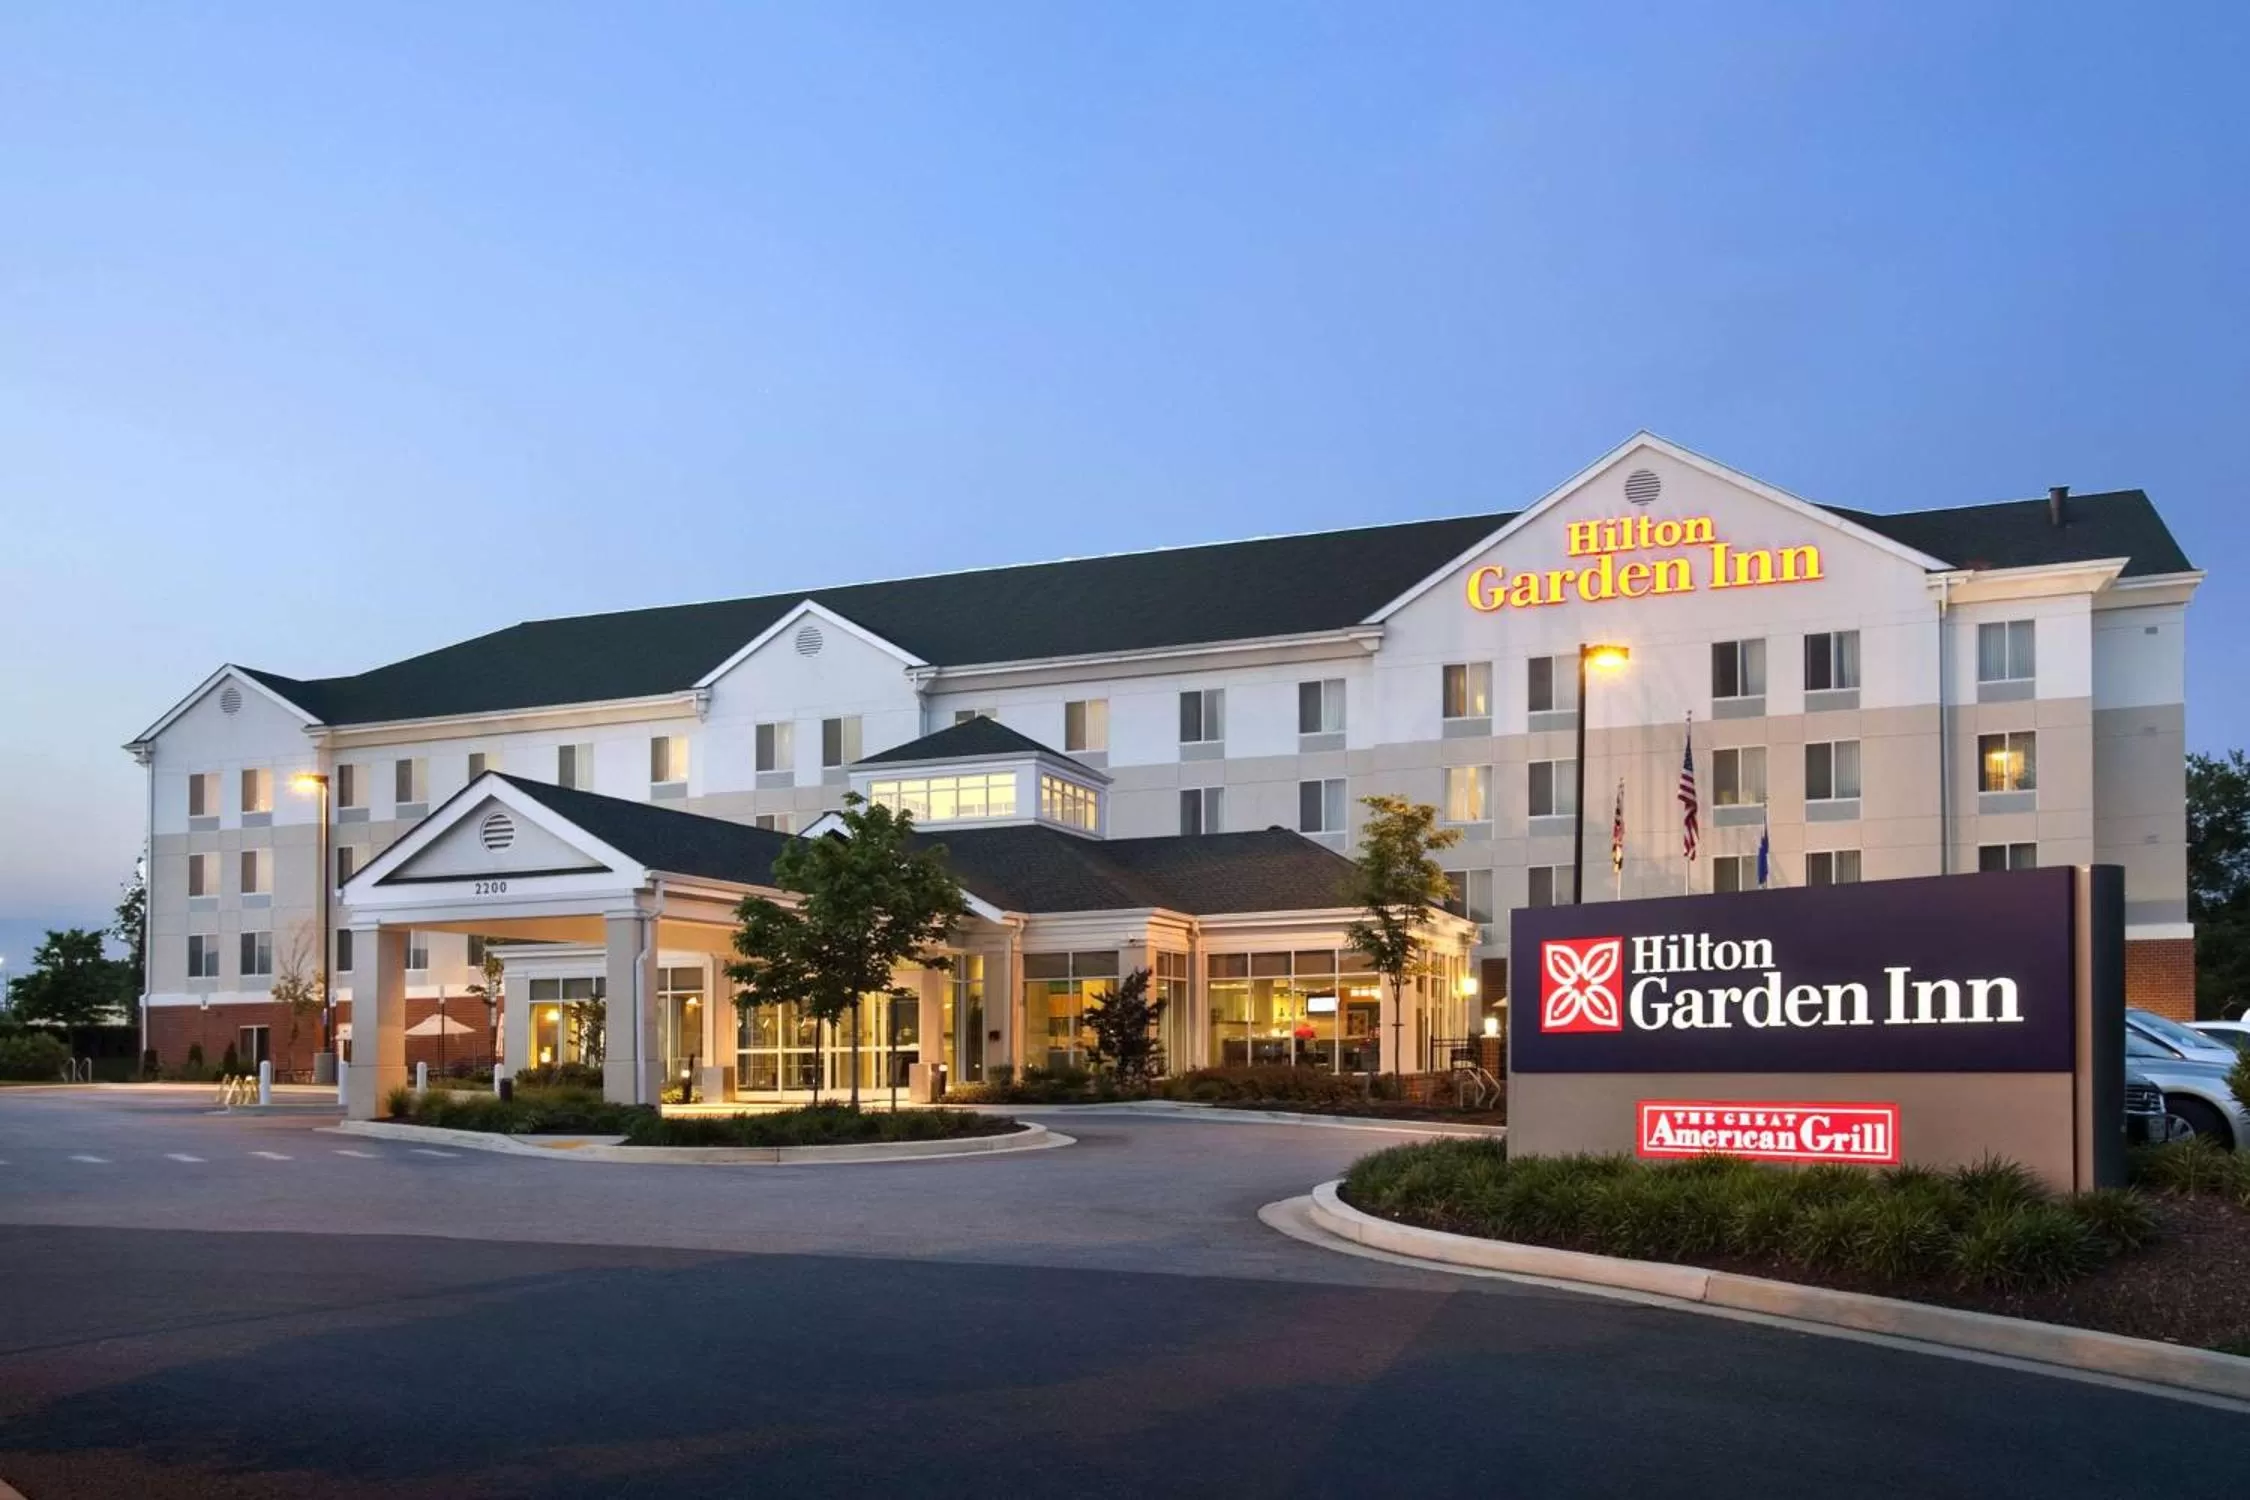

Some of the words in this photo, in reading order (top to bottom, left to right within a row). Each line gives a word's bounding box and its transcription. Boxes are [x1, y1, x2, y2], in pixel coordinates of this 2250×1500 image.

[1567, 515, 1716, 556] Hilton
[1466, 554, 1696, 613] Garden
[1708, 542, 1824, 589] Inn
[475, 881, 507, 895] 2200
[1631, 933, 1776, 974] Hilton
[1629, 971, 1874, 1031] Garden
[1884, 966, 2025, 1025] Inn
[1648, 1112, 1798, 1151] American
[1800, 1114, 1887, 1153] Grill
[1674, 1112, 1716, 1125] THE
[1724, 1112, 1797, 1127] GREAT
